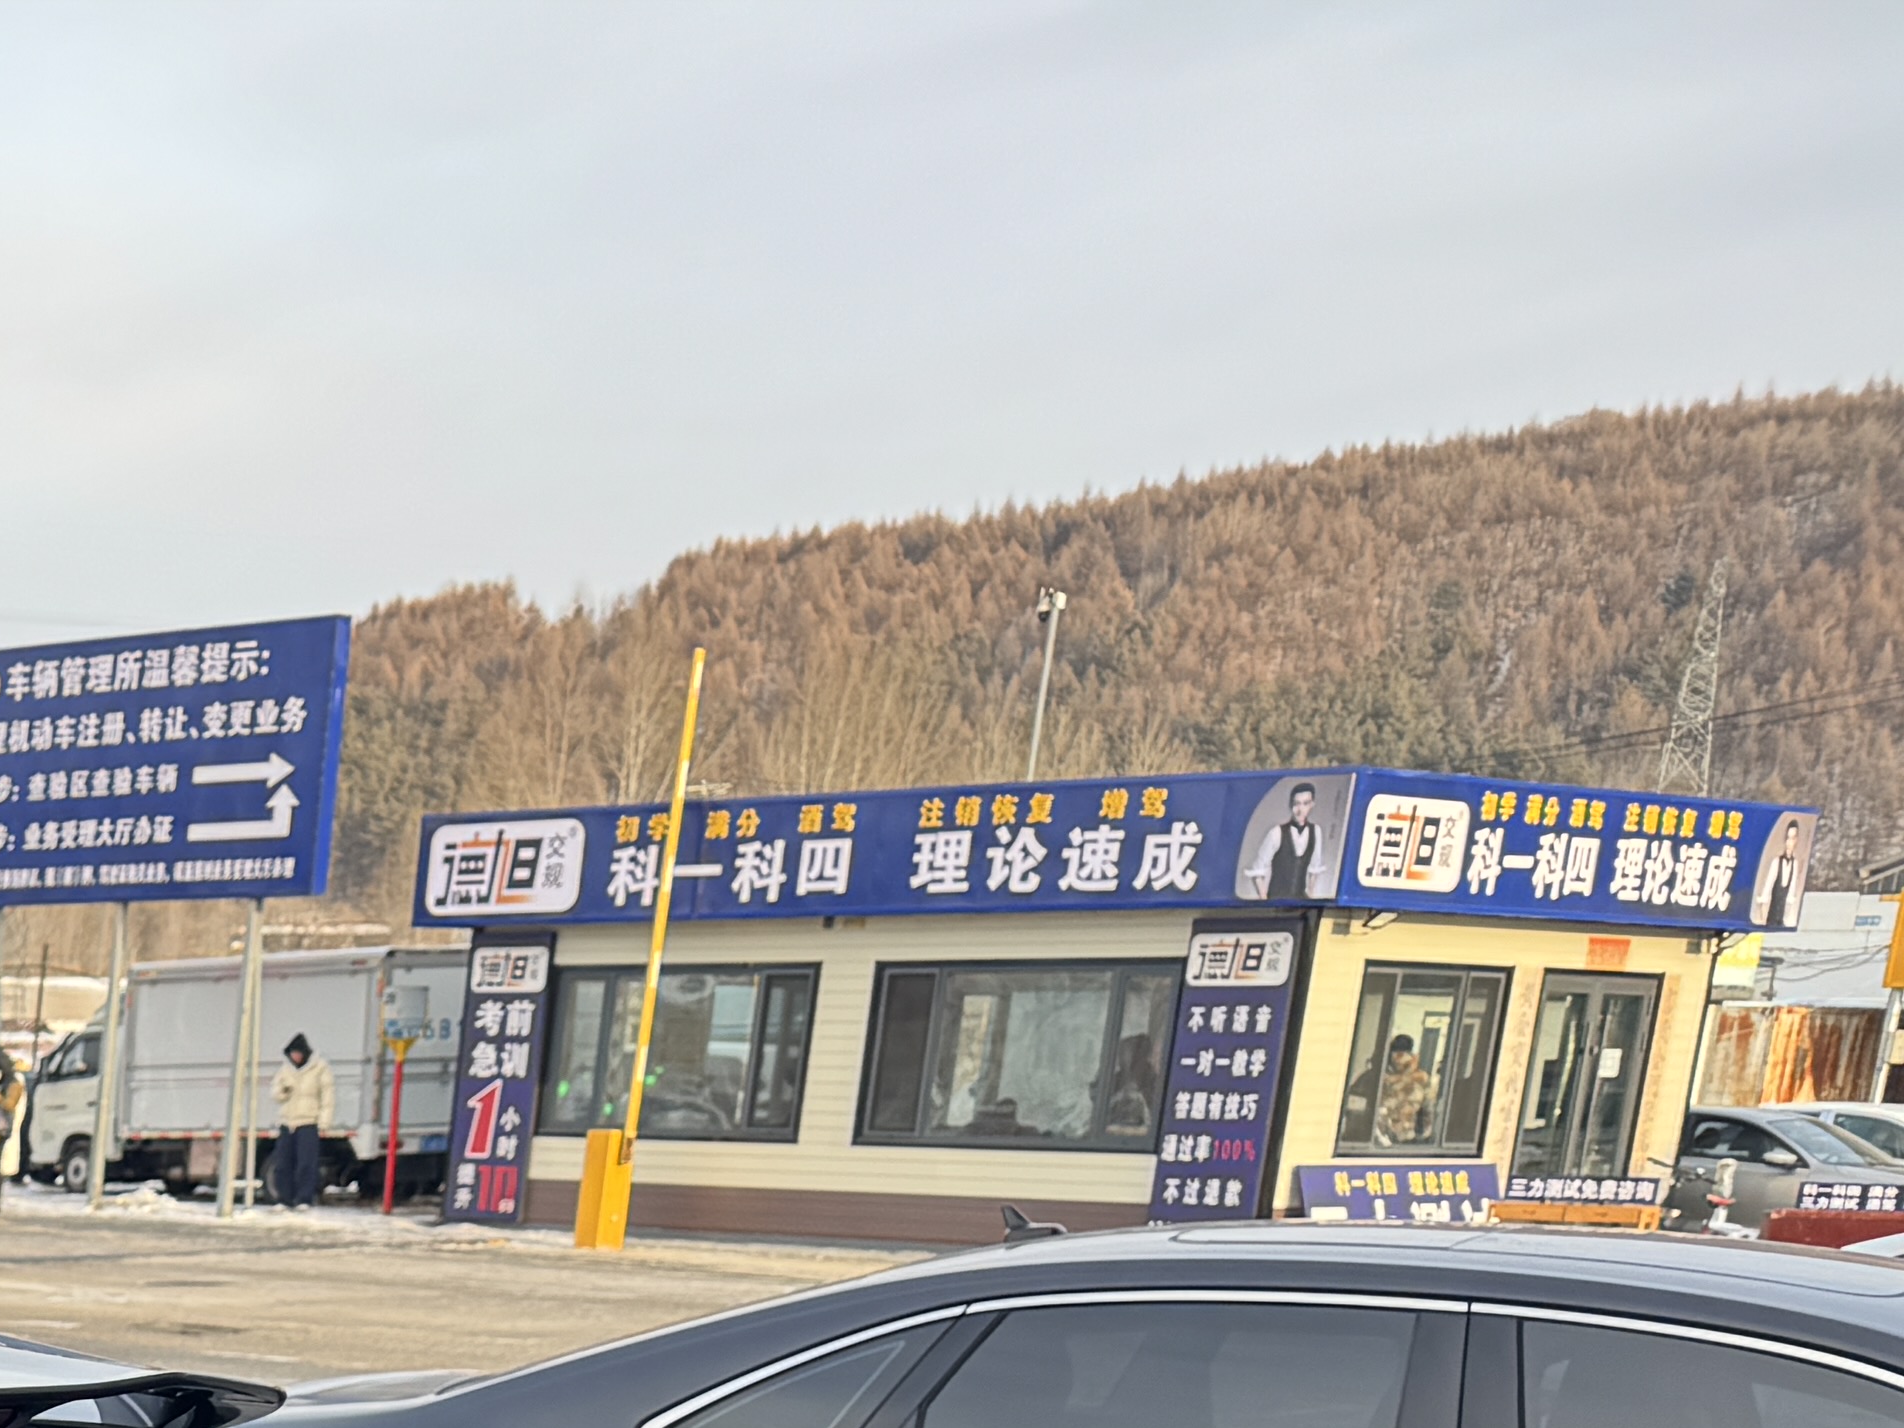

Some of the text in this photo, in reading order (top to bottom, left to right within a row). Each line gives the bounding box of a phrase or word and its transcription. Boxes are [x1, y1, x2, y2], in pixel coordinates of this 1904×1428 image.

[918, 792, 1054, 828] 注销恢复
[608, 821, 1203, 907] 科一科四 理论速成
[1467, 826, 1738, 912] 科一科四 理论速成
[474, 999, 536, 1037] 考前
[1187, 1004, 1272, 1033] 不听语音
[468, 1041, 531, 1079] 急训
[1180, 1048, 1267, 1077] 一对一教学
[464, 1078, 504, 1160] 1
[496, 1105, 522, 1161] 小时
[1508, 1177, 1656, 1202] 三力测试免费咨询
